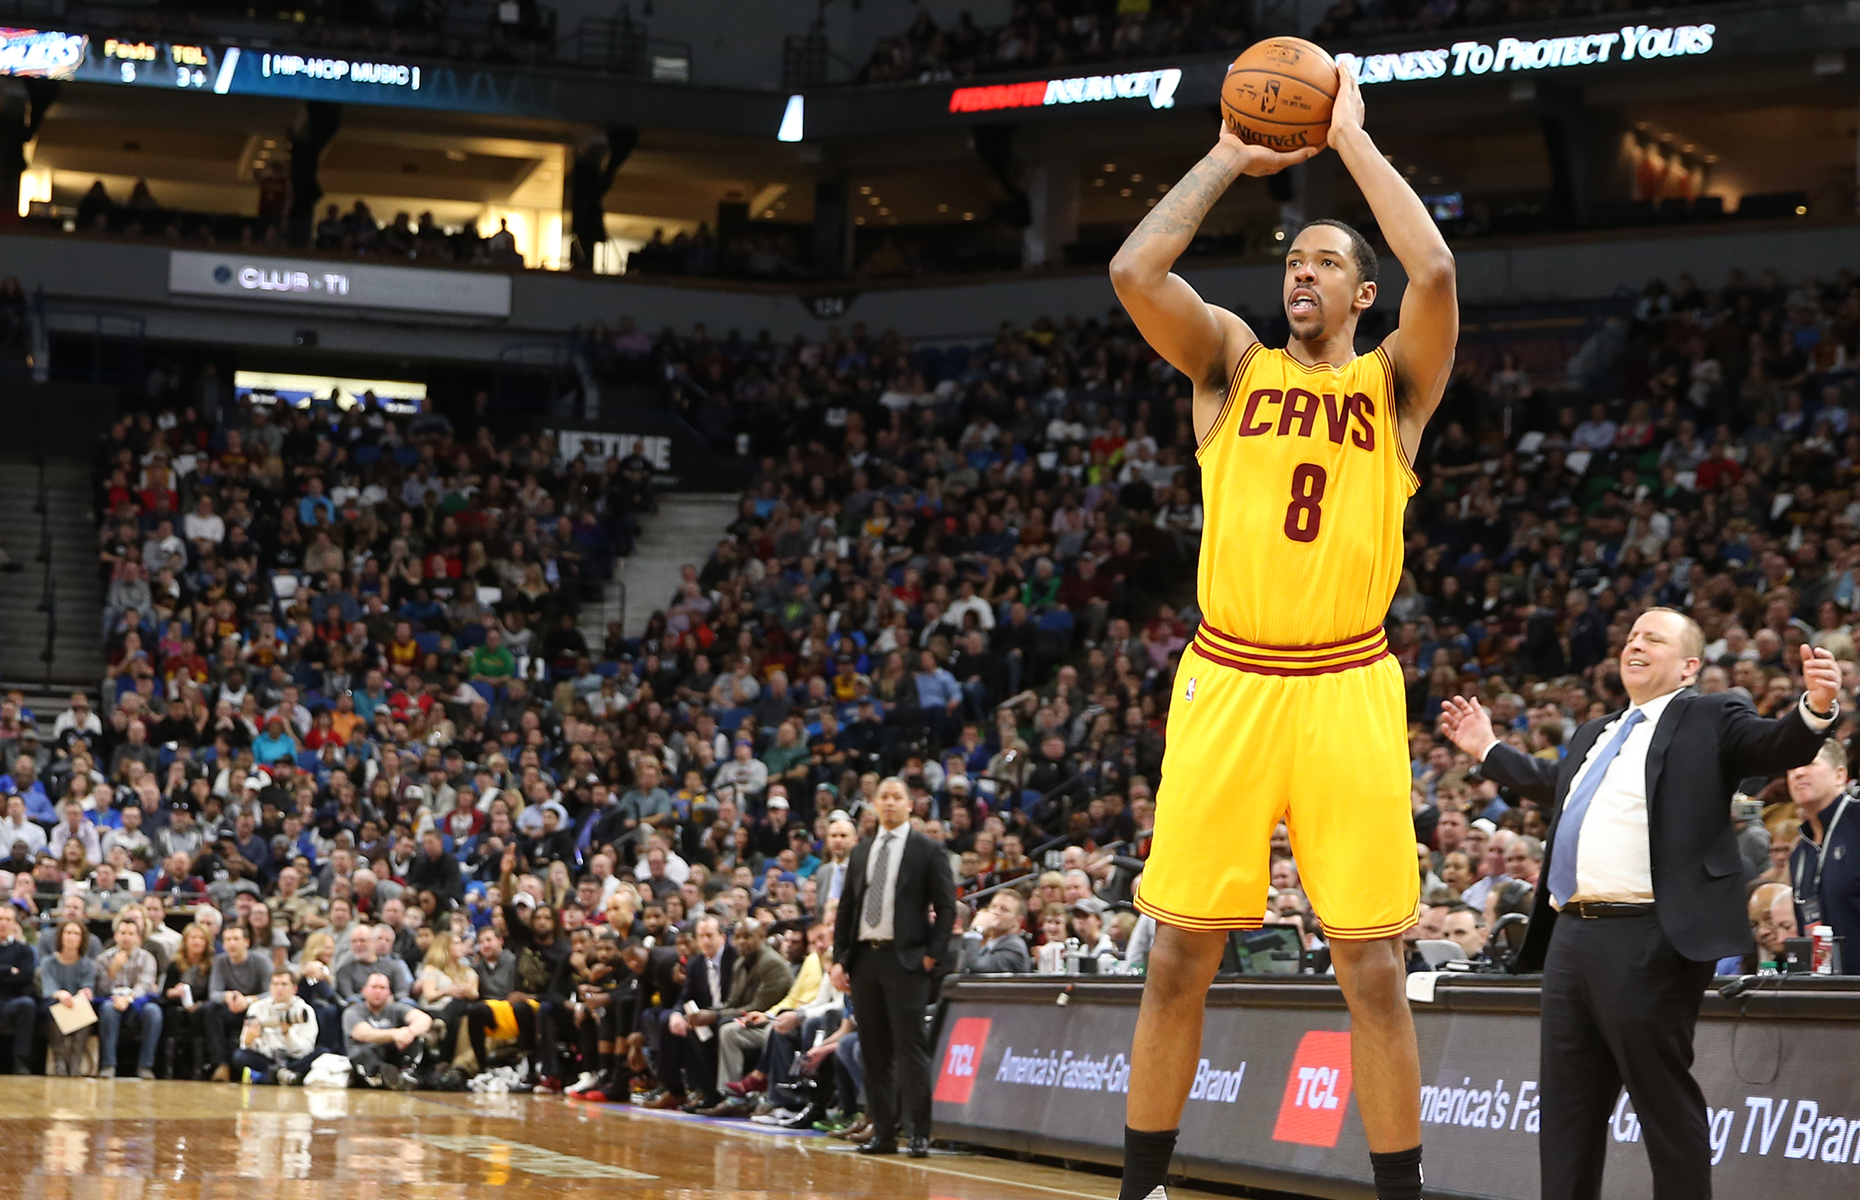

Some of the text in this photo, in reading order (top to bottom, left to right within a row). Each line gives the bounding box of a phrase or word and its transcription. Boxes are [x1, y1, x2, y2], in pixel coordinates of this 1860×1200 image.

[238, 266, 310, 292] CLUB
[1238, 387, 1376, 452] CAVS
[1284, 462, 1328, 543] 8
[947, 1044, 976, 1077] TCL
[995, 1046, 1060, 1087] America's
[1189, 1058, 1247, 1103] Brand
[1295, 1066, 1340, 1109] TCL
[1420, 1076, 1510, 1130] merica's
[1739, 1096, 1789, 1156] TV
[1784, 1100, 1860, 1165] Bran
